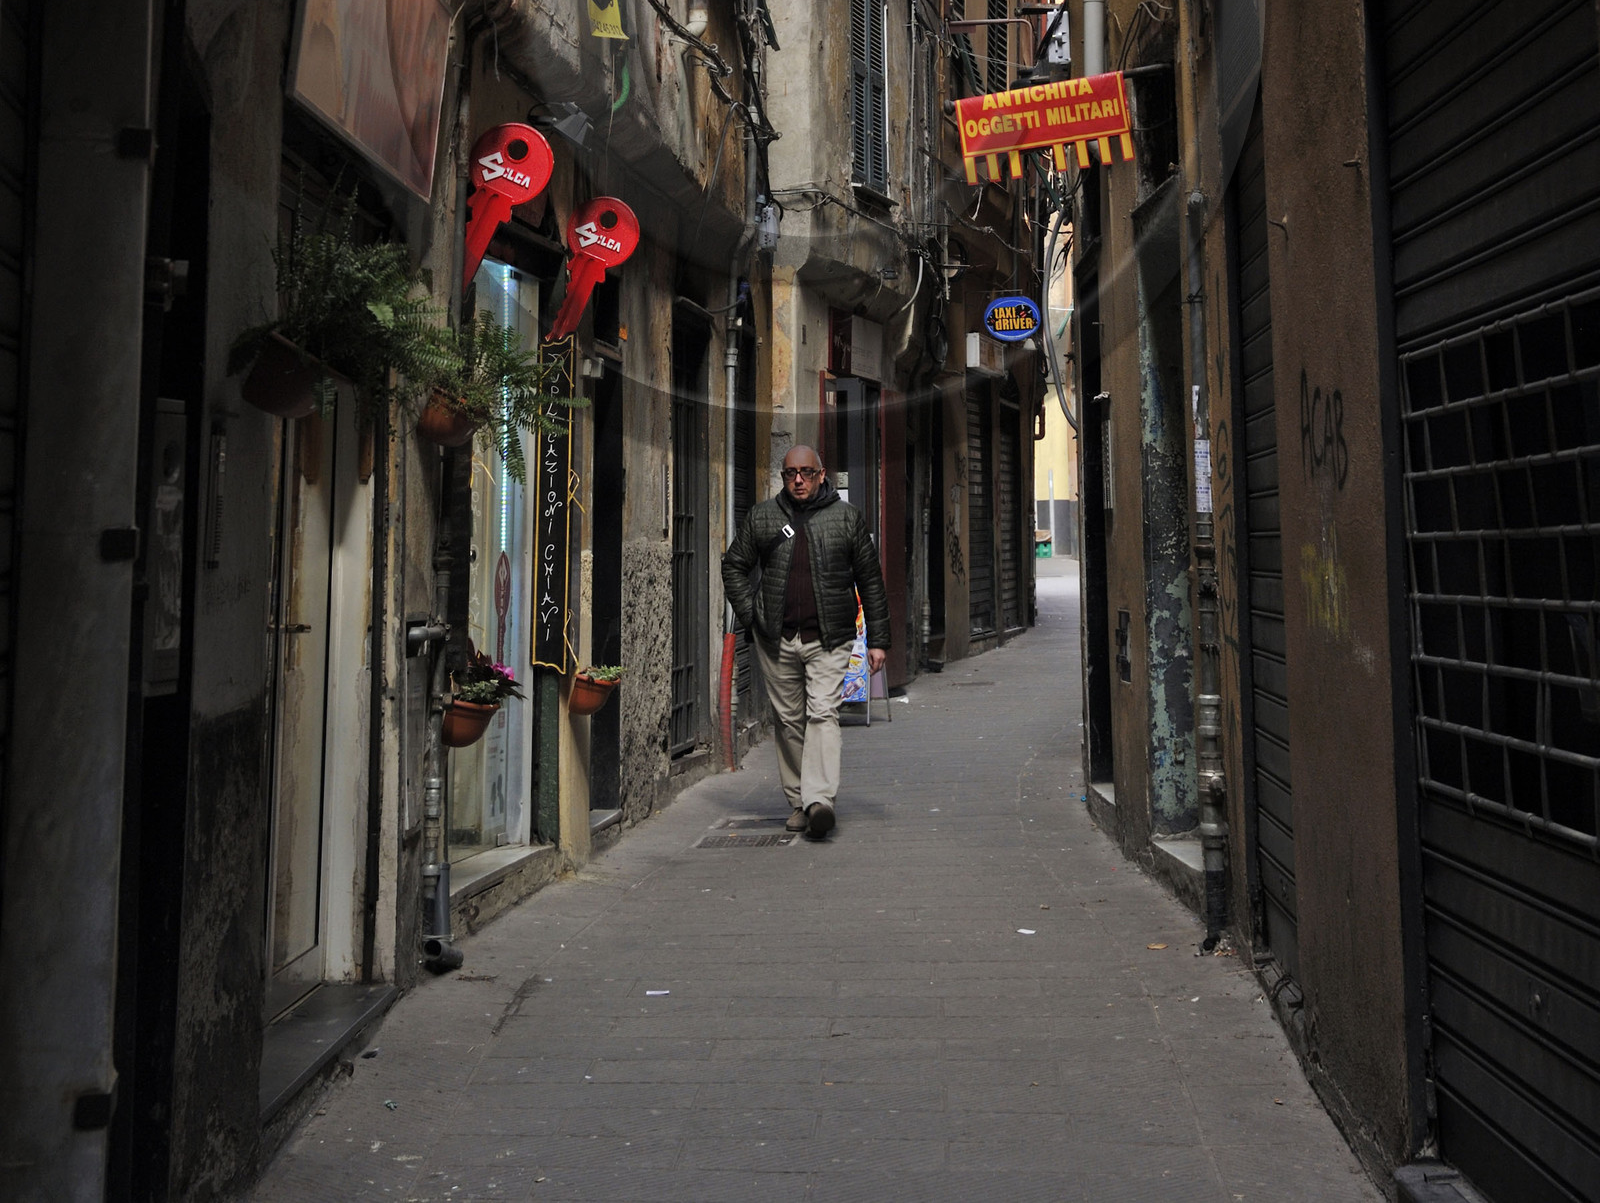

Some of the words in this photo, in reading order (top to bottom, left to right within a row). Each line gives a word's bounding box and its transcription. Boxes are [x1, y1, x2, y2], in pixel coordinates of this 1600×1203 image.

[965, 110, 1040, 138] OGGETTI
[1046, 97, 1119, 127] MILITARI
[1300, 367, 1349, 490] ACAB
